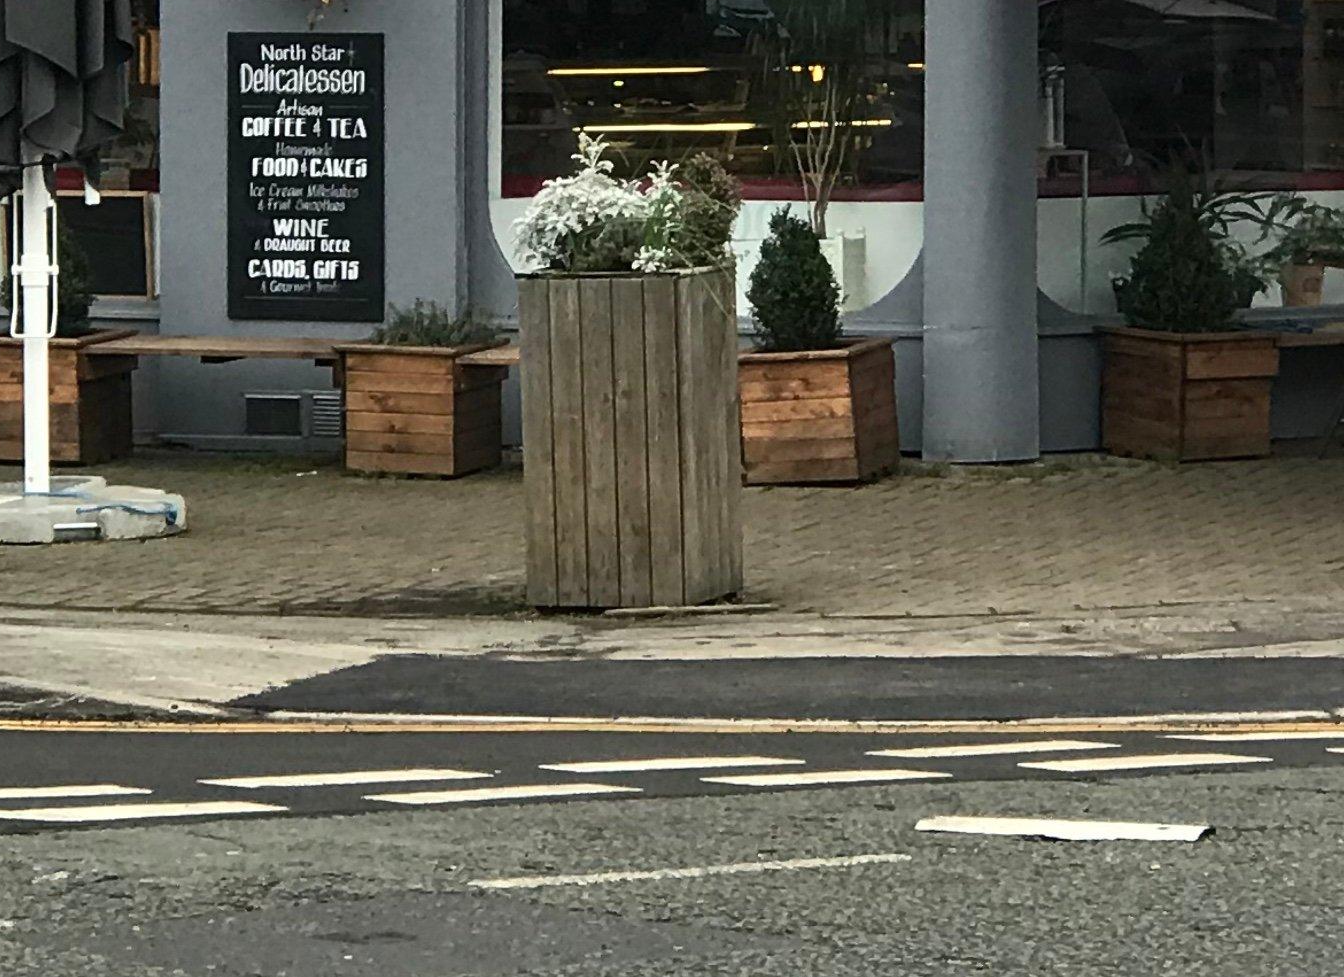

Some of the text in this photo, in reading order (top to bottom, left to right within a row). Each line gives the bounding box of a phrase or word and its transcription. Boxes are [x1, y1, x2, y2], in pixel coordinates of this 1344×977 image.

[259, 43, 346, 62] North Star
[239, 62, 366, 94] Delicatessen
[276, 97, 324, 117] Artisan
[241, 116, 308, 138] COFFEE
[326, 116, 368, 139] TEA
[251, 156, 299, 178] FOOD
[309, 156, 368, 179] CAKES
[249, 181, 265, 198] Ice
[268, 182, 304, 198] Cream
[272, 217, 330, 238] WINE
[263, 236, 316, 253] DRAUGHT
[320, 238, 351, 253] BEER
[313, 259, 361, 281] GIFTS
